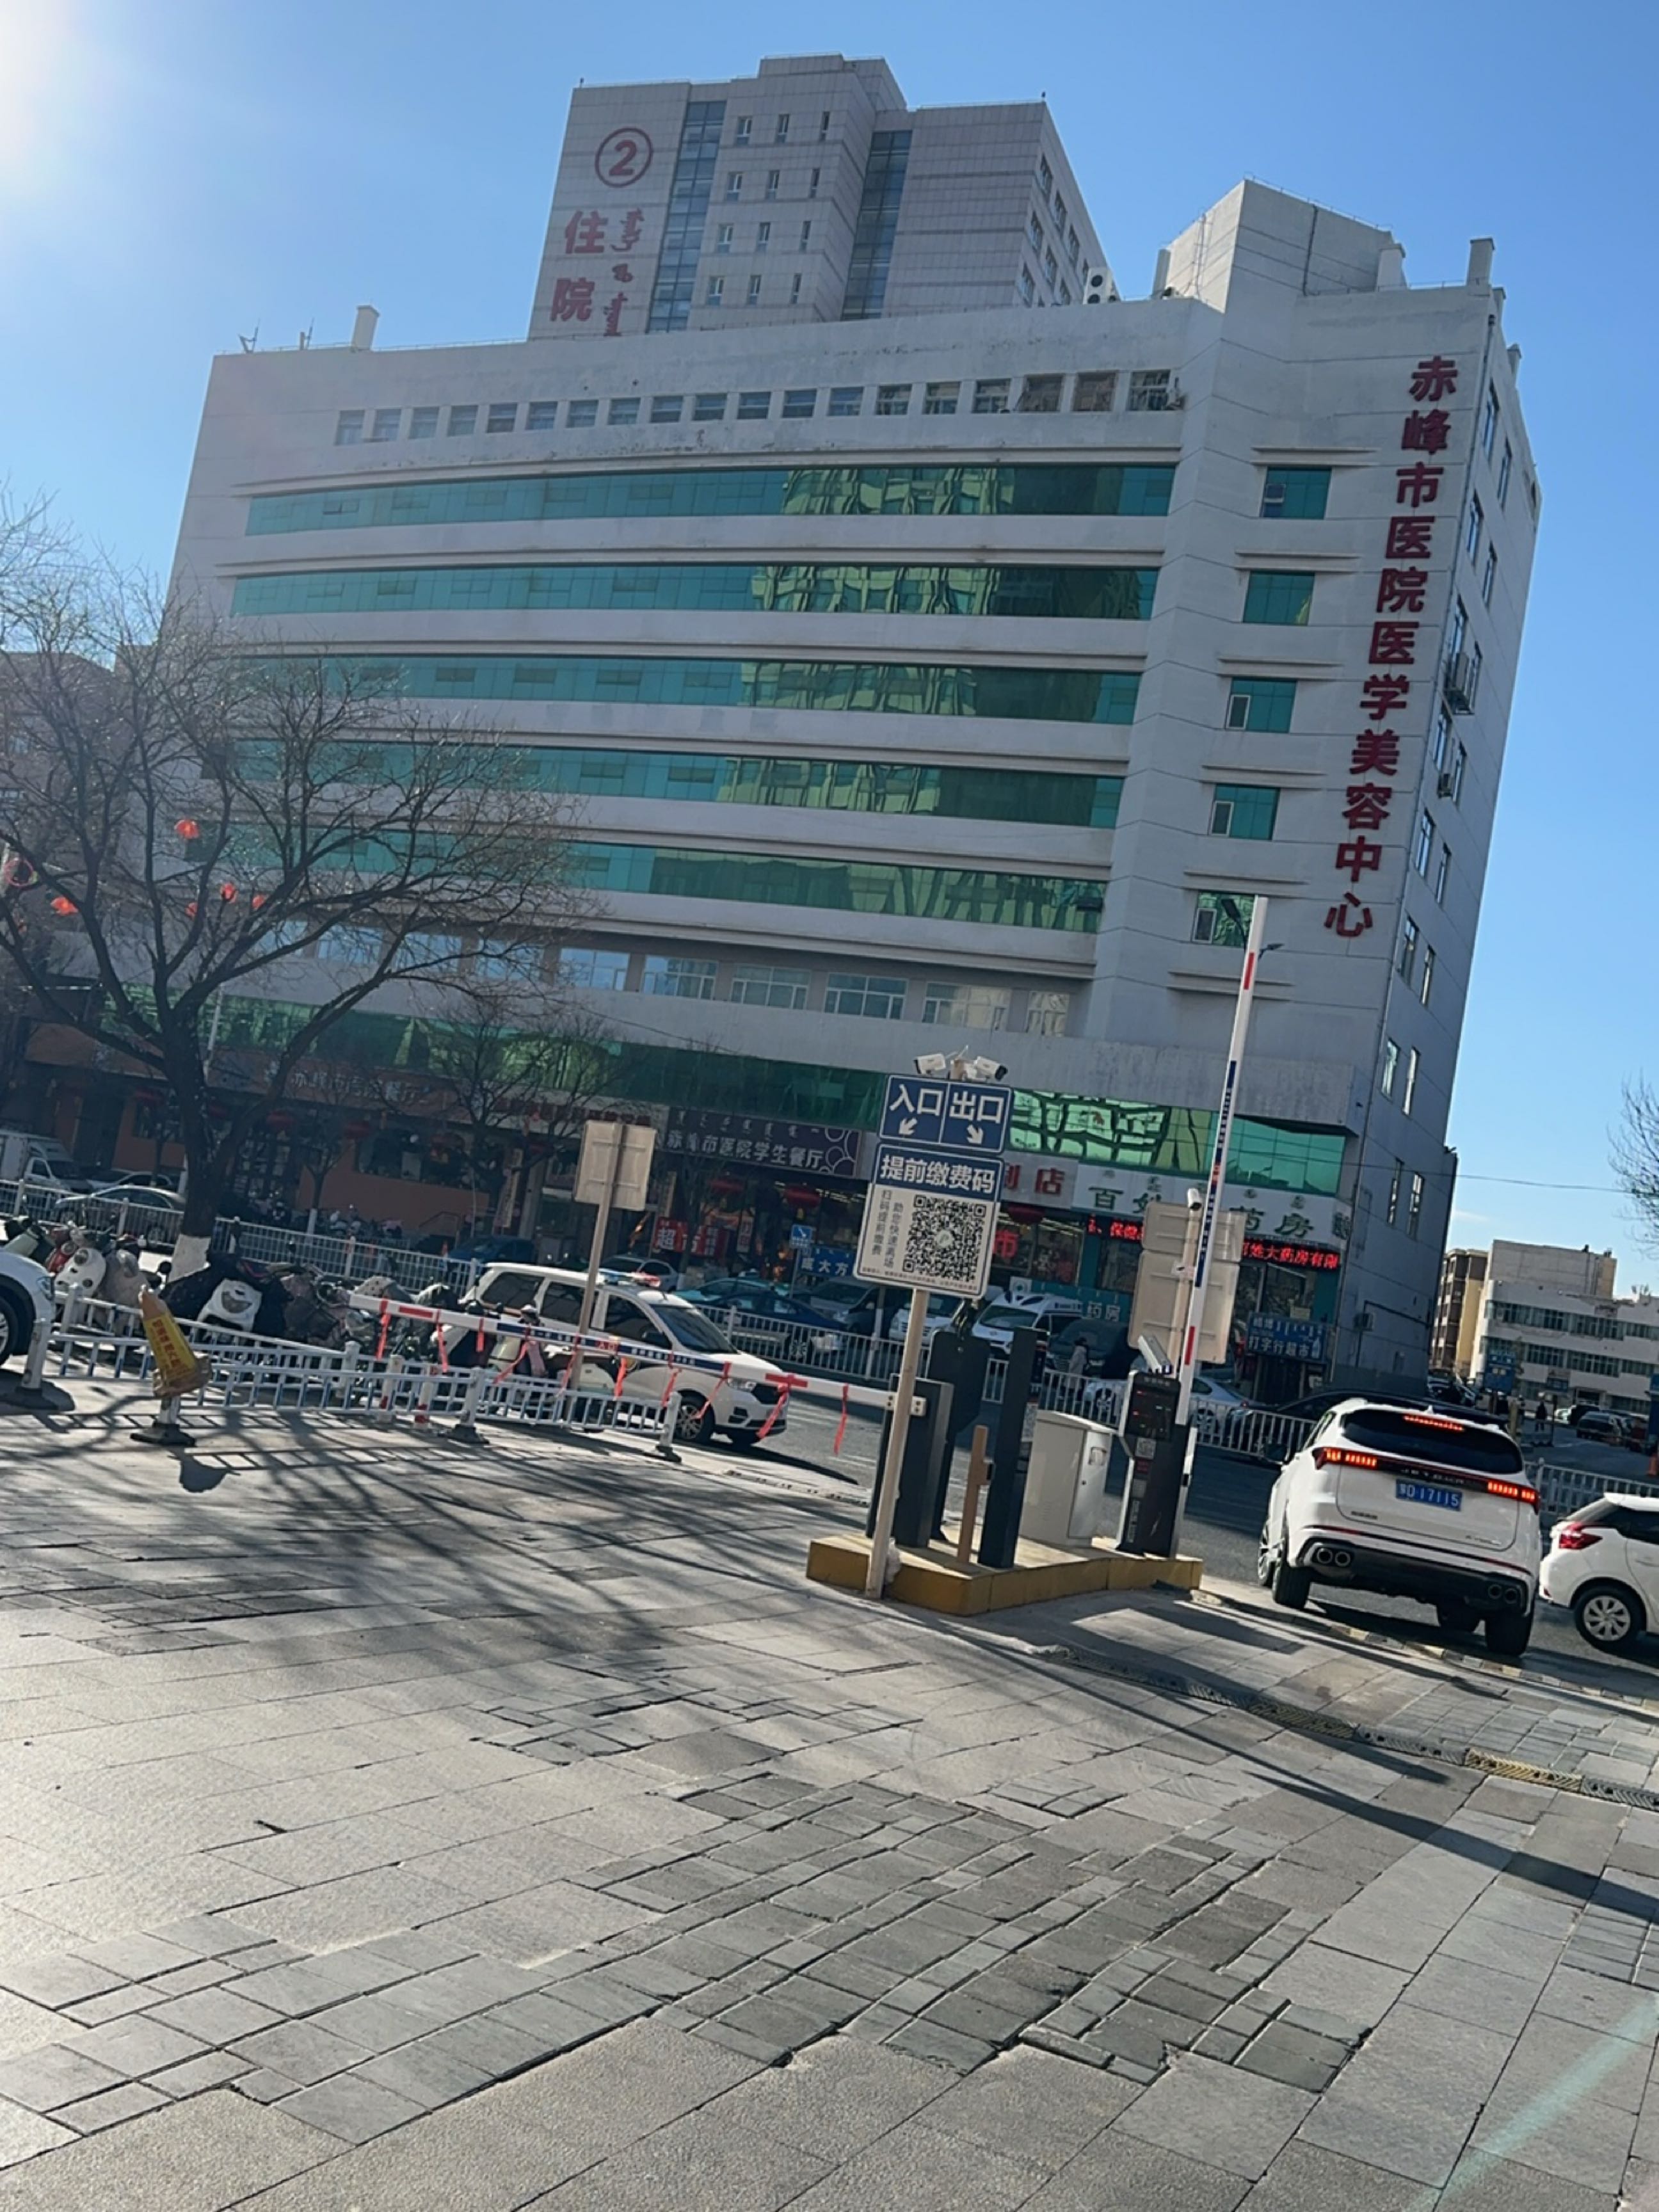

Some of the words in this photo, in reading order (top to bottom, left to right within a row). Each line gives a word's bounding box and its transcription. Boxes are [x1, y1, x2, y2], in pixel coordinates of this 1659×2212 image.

[550, 209, 609, 322] 住院
[1324, 356, 1458, 938] 赤峰市医院医学美容中心
[889, 1084, 943, 1116] 入口
[949, 1090, 1004, 1124] 出口
[879, 1154, 995, 1194] 提前缴费码
